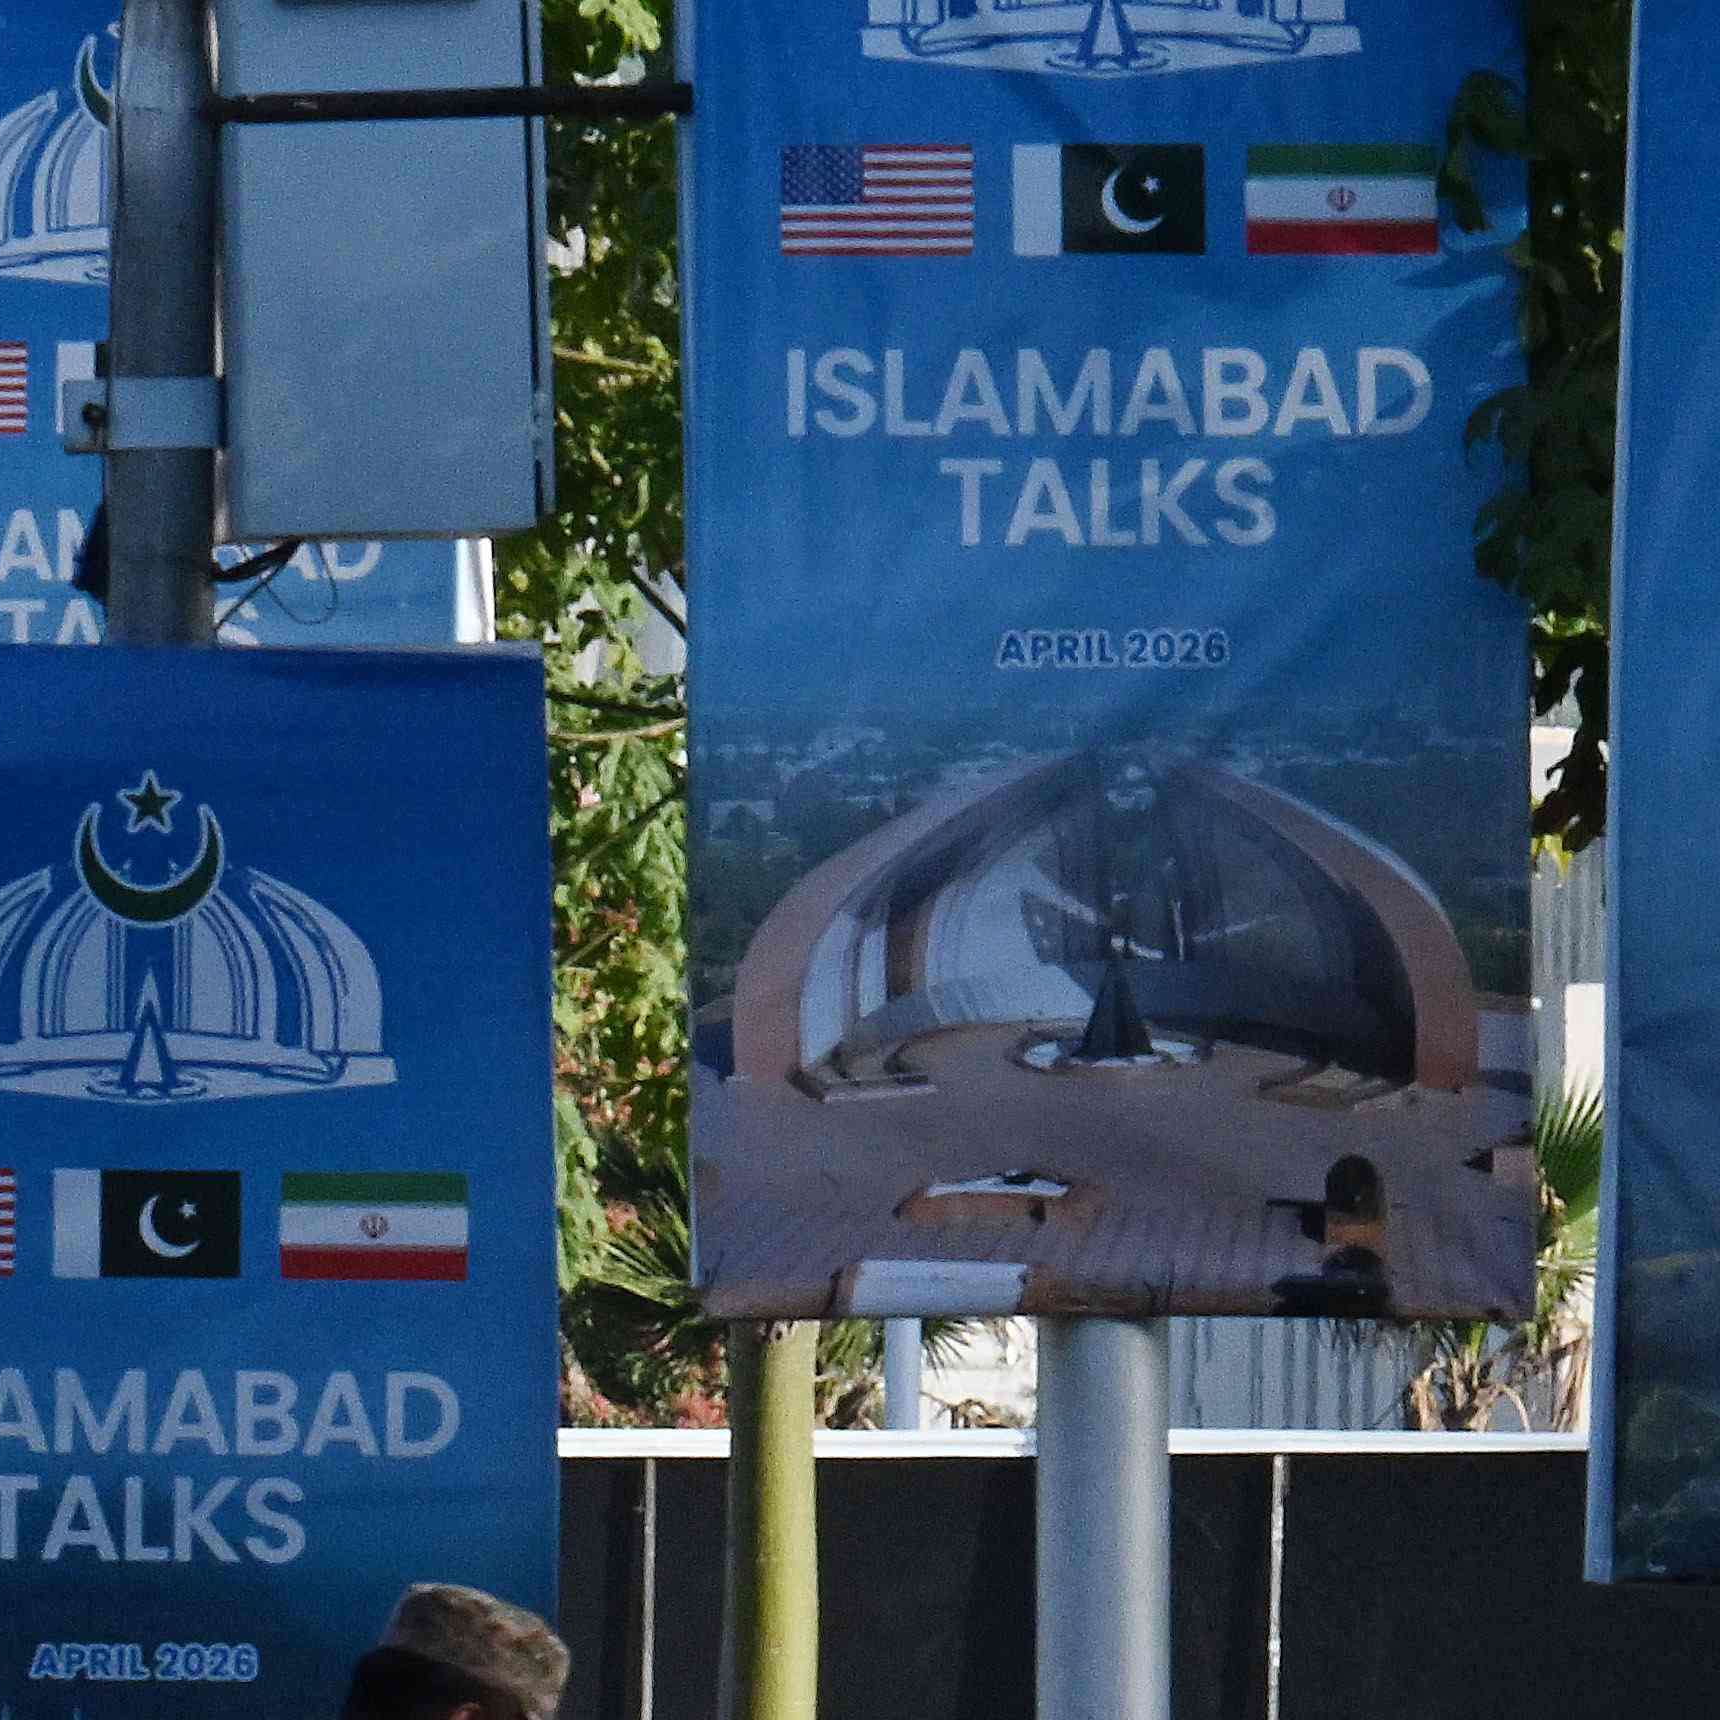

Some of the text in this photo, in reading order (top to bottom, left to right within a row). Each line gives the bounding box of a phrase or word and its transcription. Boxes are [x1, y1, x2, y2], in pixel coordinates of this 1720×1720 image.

[787, 347, 1434, 438] ISLAMABAD
[938, 456, 1277, 547] TALKS
[997, 629, 1231, 669] APRIL 2026
[29, 1642, 260, 1682] APRIL 2026
